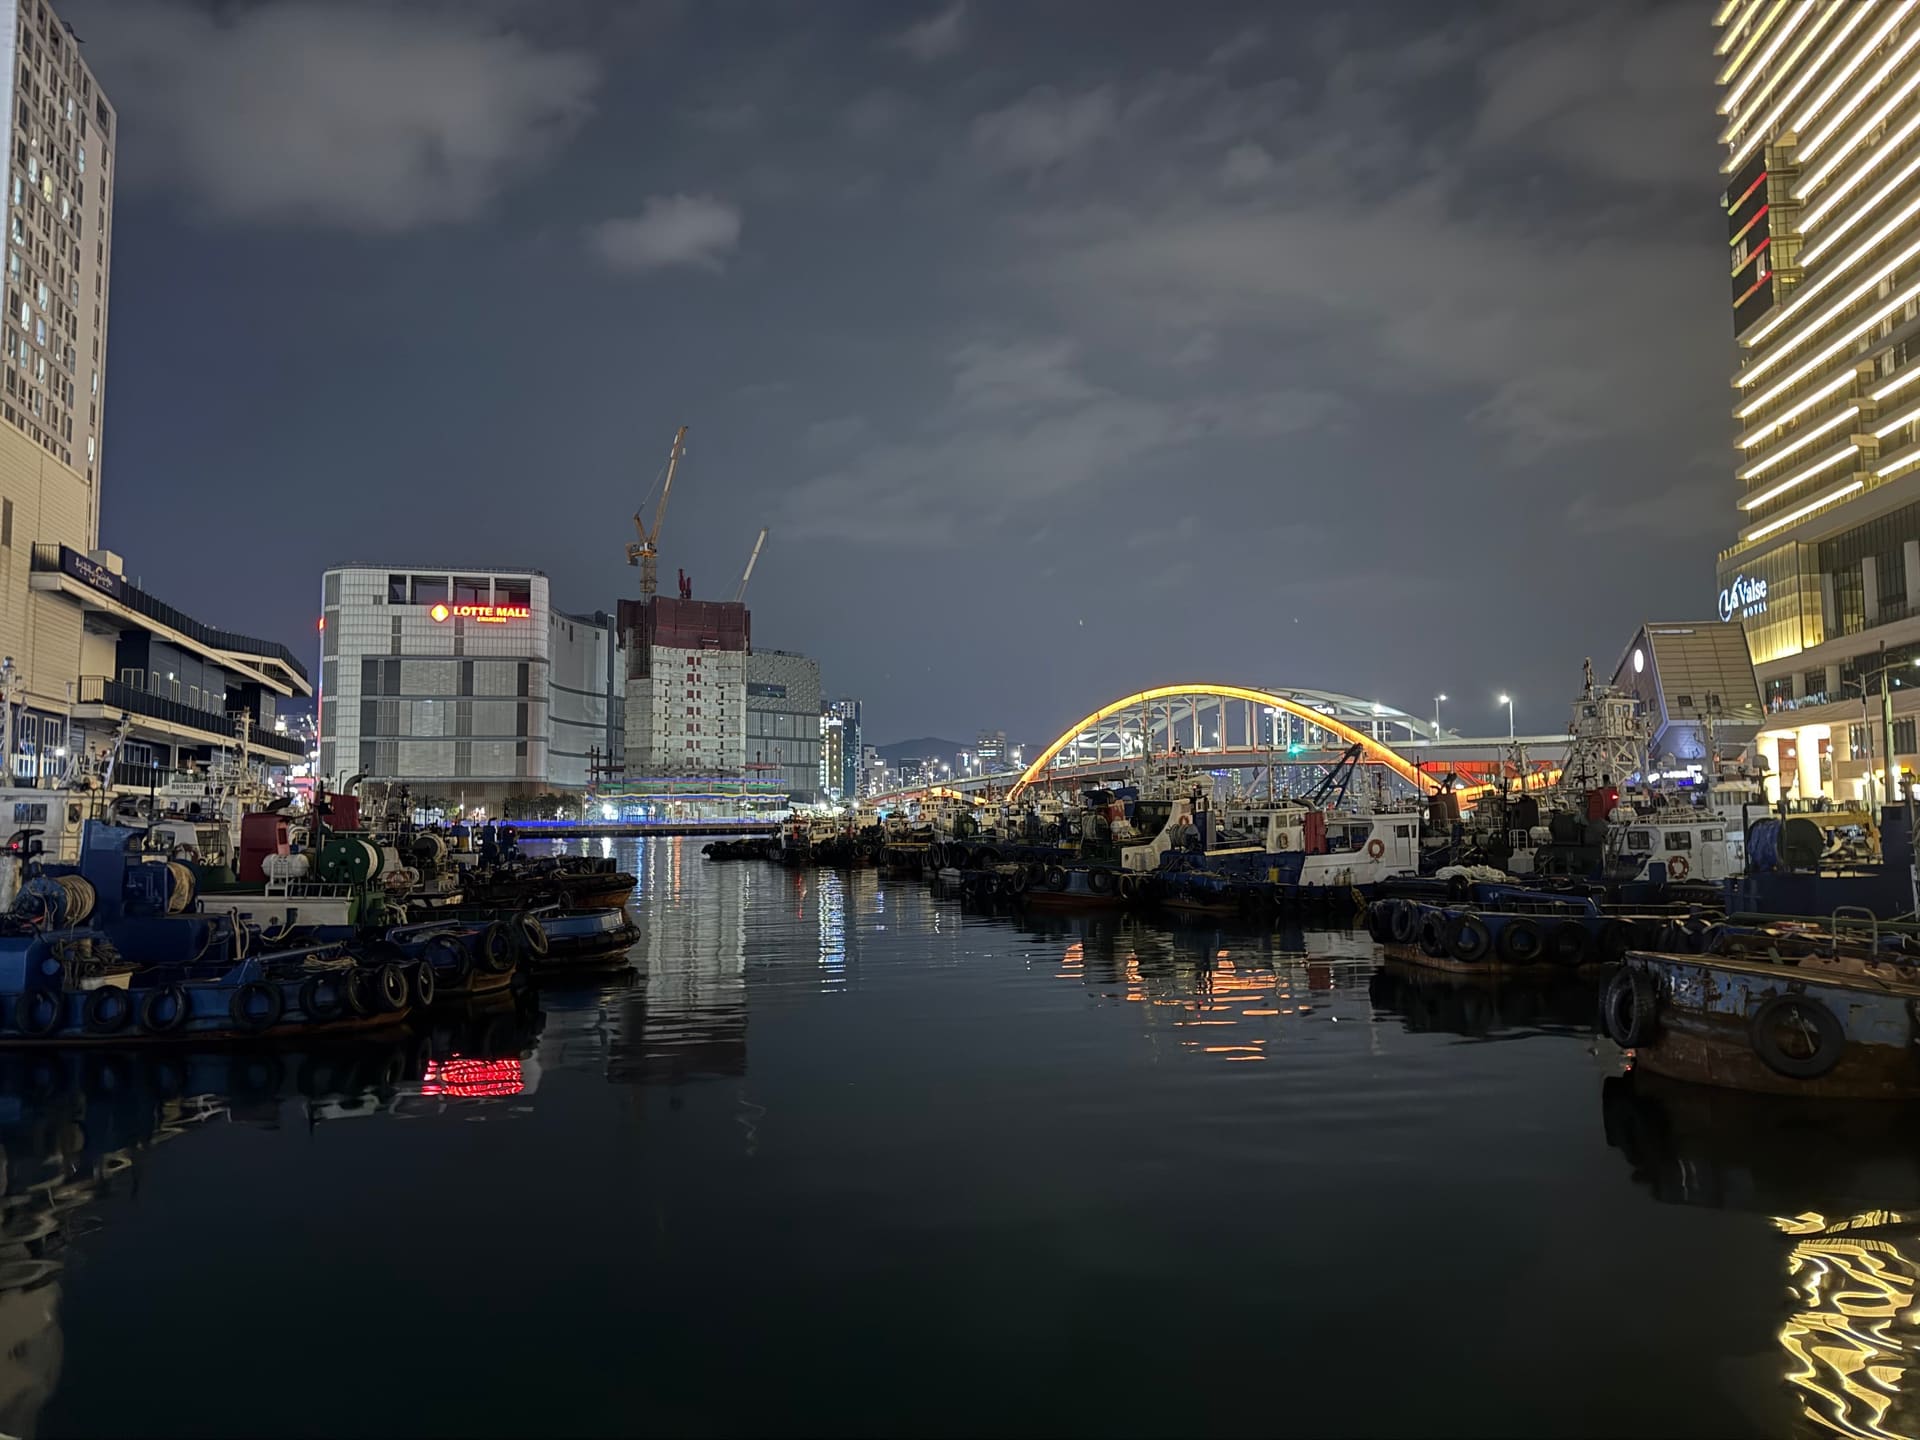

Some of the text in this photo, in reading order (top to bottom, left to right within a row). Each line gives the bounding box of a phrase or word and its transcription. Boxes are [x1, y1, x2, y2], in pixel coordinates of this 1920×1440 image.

[1738, 577, 1767, 605] Valse
[453, 606, 530, 617] LOTTE MALL
[1743, 601, 1767, 619] HOTEL
